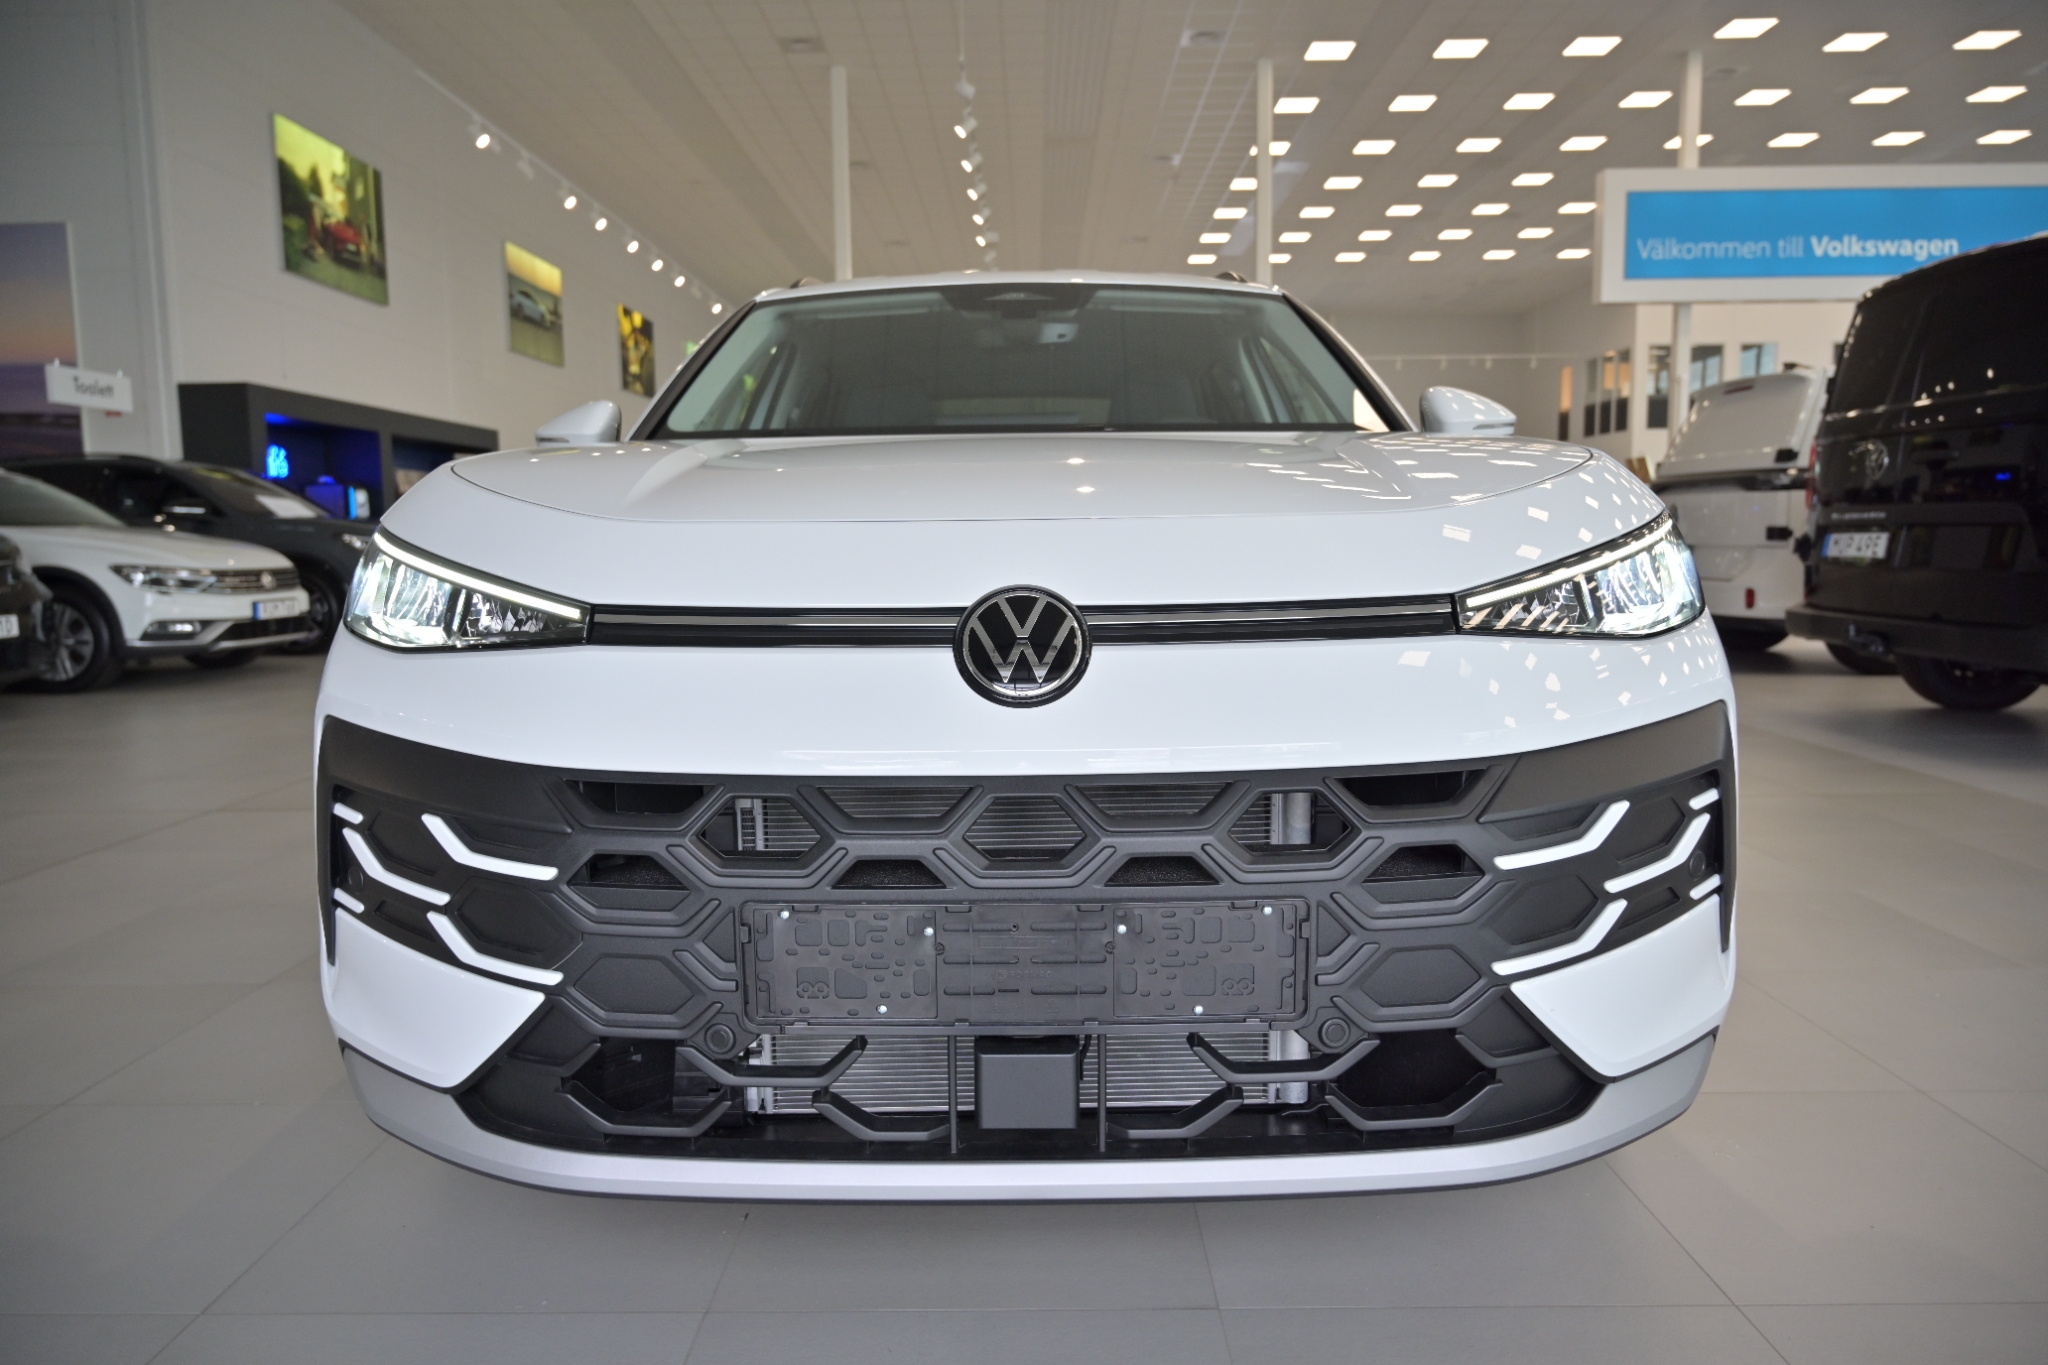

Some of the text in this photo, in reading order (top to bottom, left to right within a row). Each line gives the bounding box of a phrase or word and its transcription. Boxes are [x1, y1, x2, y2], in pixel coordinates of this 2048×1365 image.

[1637, 234, 1959, 262] Välkommen till Volkswagen
[72, 375, 114, 398] Toalett
